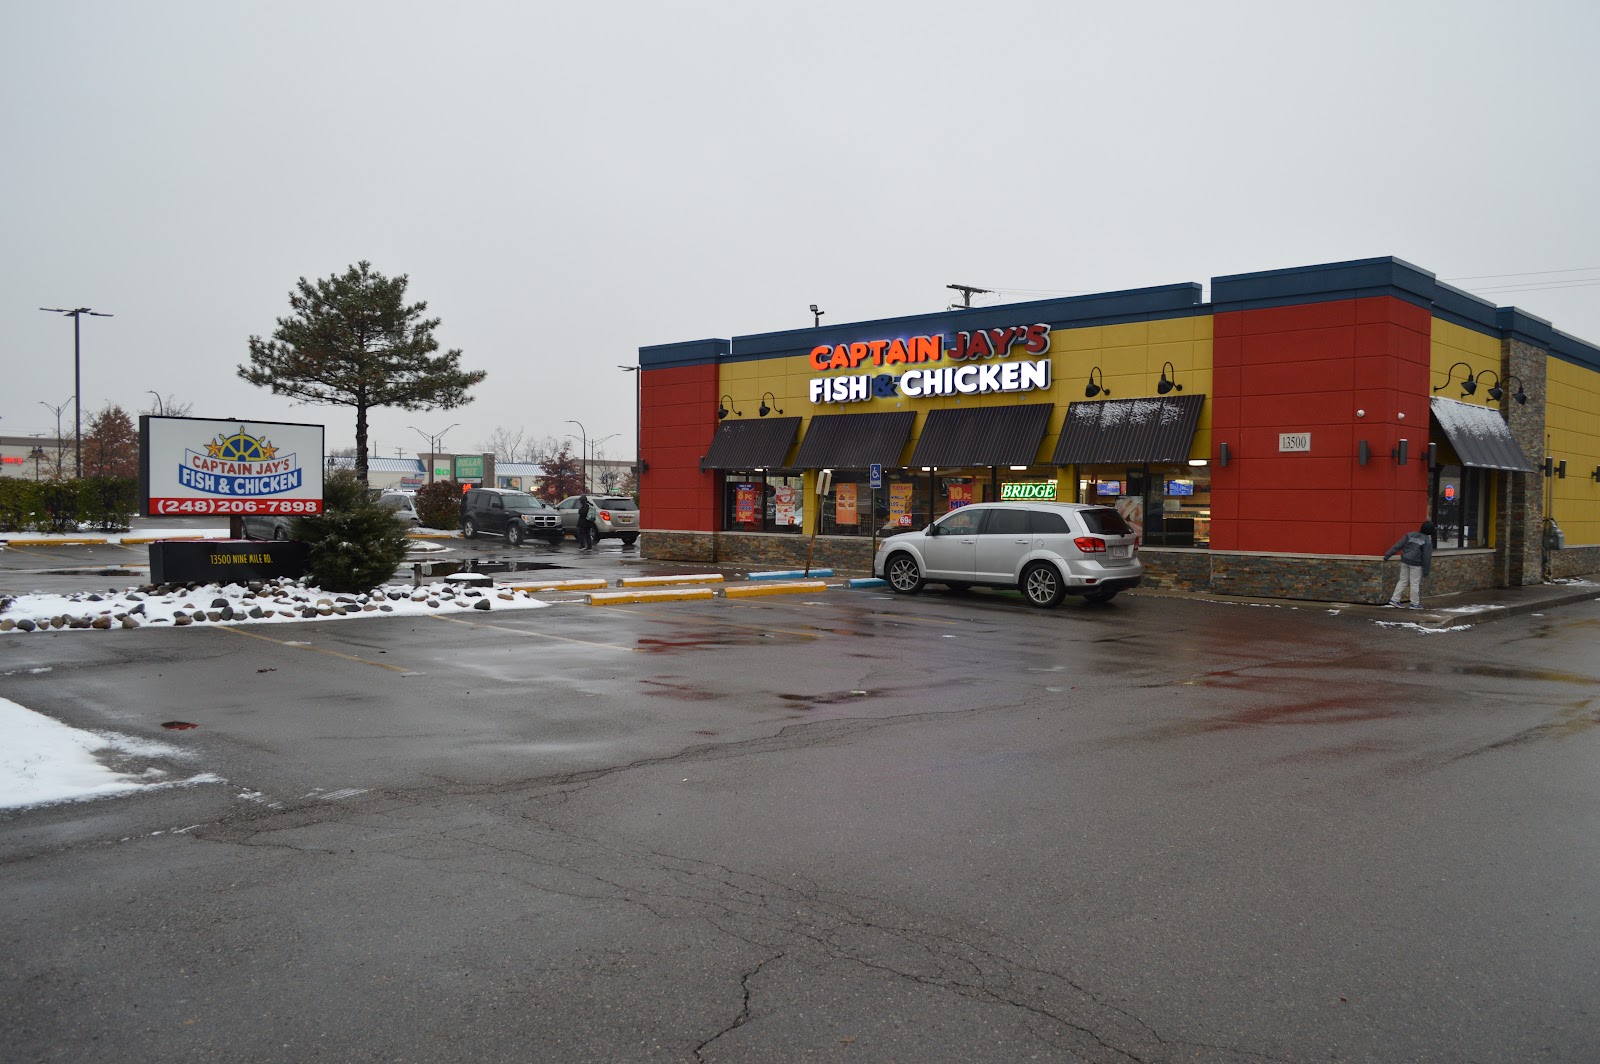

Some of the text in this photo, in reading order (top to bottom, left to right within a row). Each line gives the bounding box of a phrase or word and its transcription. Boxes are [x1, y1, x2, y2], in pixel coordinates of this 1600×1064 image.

[809, 323, 1051, 371] CAPTAIN JAY'S
[809, 359, 1051, 404] FISH & CHICKEN
[1282, 435, 1307, 449] 13500
[192, 455, 289, 475] CAPTAIN JAY'S
[457, 458, 481, 467] DOLLAR
[461, 468, 477, 477] TREE
[182, 468, 298, 494] FISH & CHICKEN
[949, 486, 962, 500] 10
[1002, 484, 1055, 498] BRIDGE
[157, 499, 317, 514] (248)206-7898
[210, 554, 231, 565] 13500
[232, 554, 248, 564] NINE
[249, 553, 263, 564] MILE
